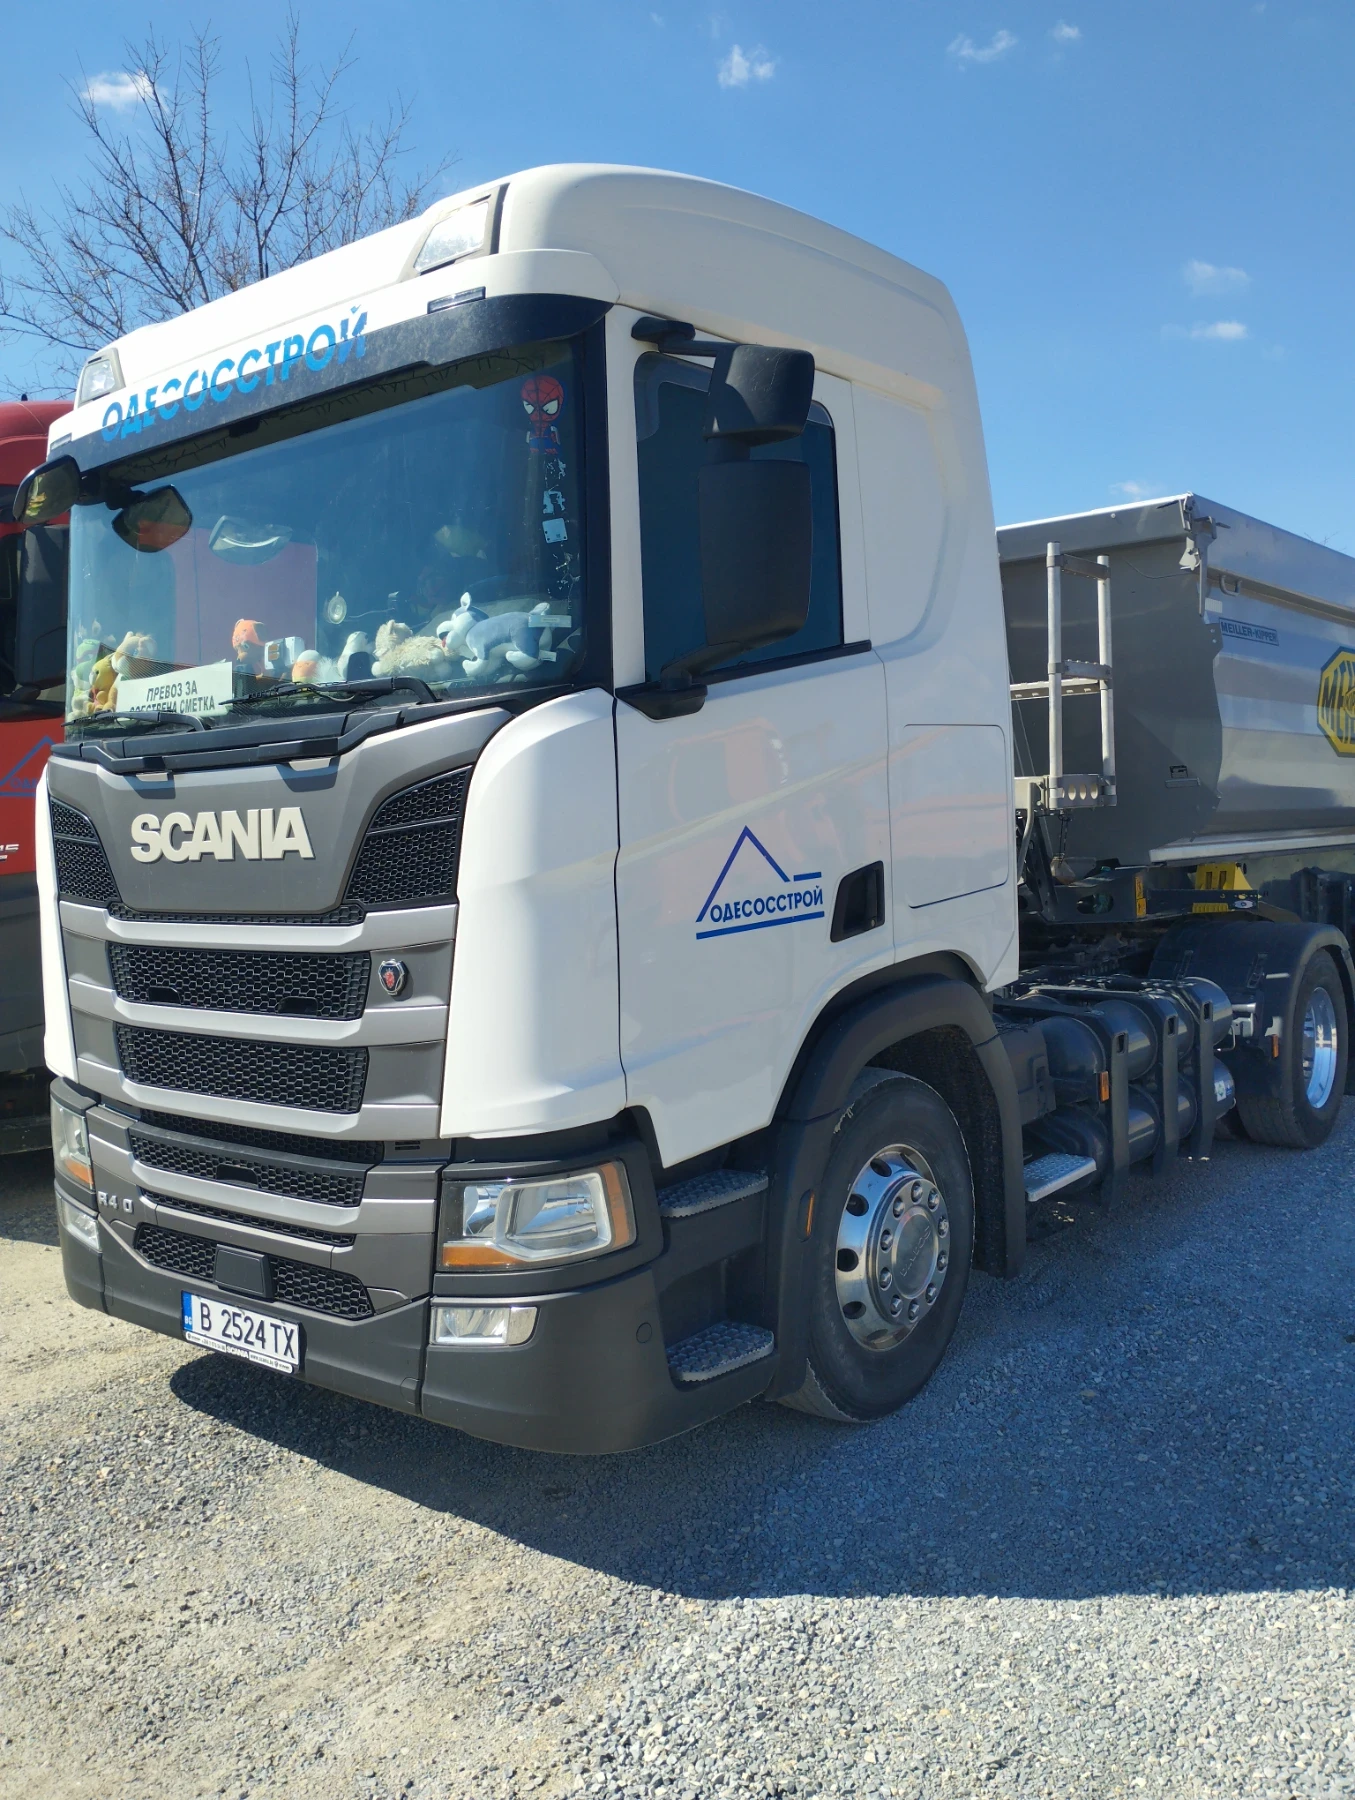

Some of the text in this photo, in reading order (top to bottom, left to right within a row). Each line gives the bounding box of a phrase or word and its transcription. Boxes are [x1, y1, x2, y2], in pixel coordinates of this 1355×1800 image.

[101, 304, 368, 442] ОДЕСОССТРОЙ
[1220, 621, 1277, 643] MEILLER-KIPPER
[146, 680, 198, 702] ПРЕВОЗ ЗА
[180, 695, 216, 714] СМЕТКА
[130, 806, 316, 864] SCANIA
[710, 885, 823, 923] ОДЕСОССТРОЙ
[184, 1315, 193, 1326] BG
[200, 1302, 296, 1360] B 2524 TX
